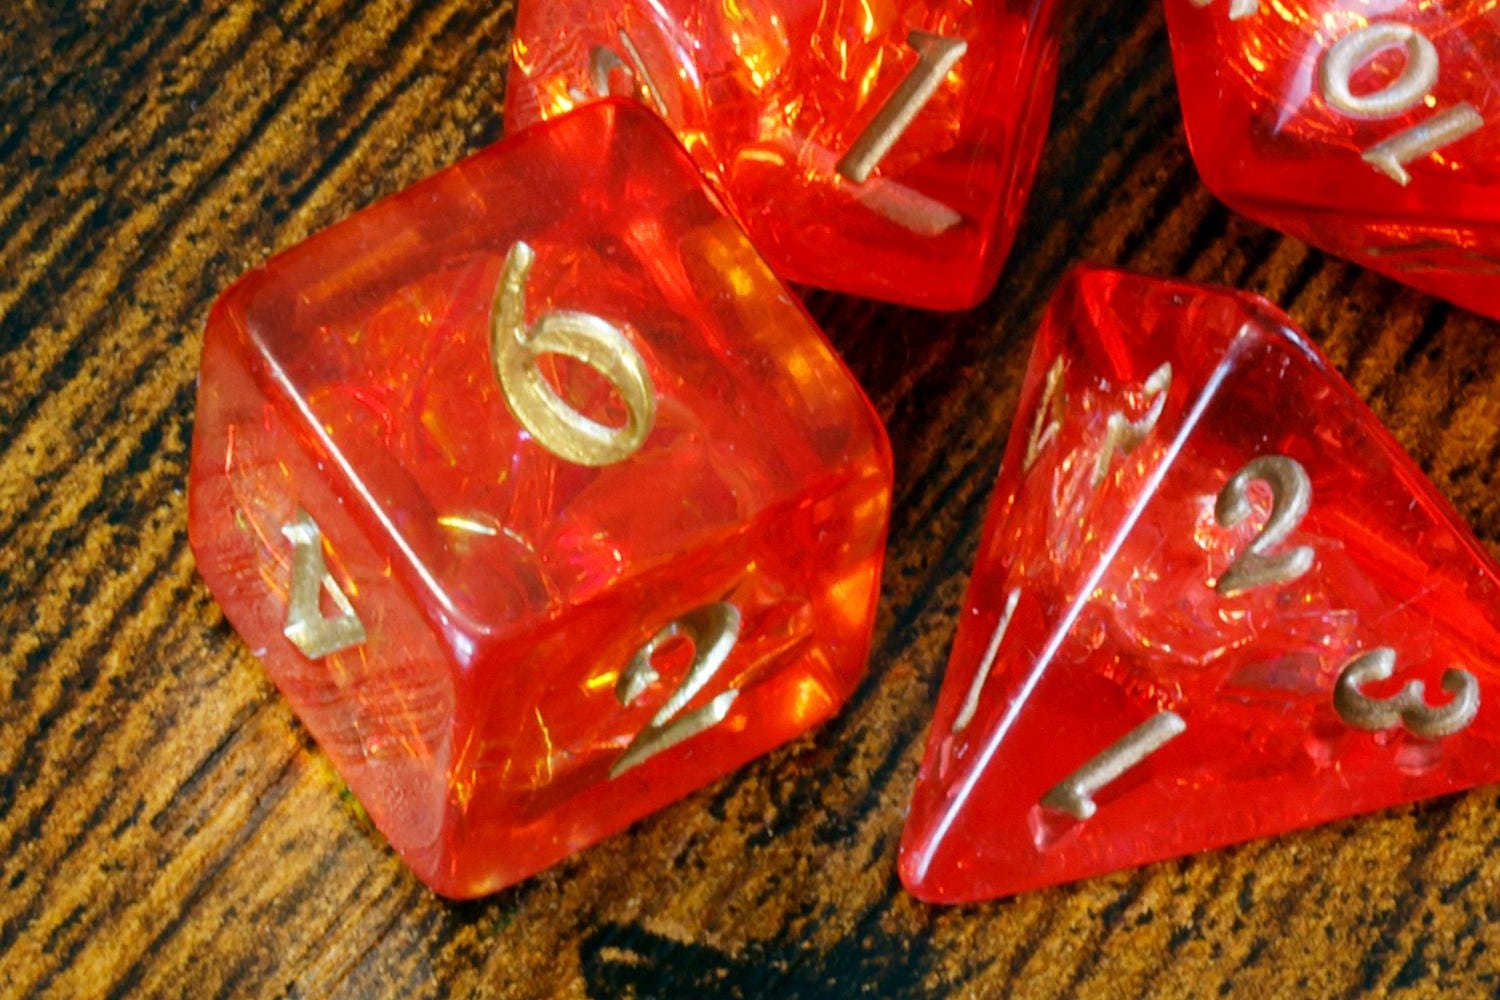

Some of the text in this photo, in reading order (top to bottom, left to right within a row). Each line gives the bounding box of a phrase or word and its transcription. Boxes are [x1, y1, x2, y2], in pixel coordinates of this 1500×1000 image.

[837, 30, 968, 183] 1
[1321, 22, 1483, 185] 10
[490, 241, 656, 467] 6
[1215, 453, 1314, 594] 2
[609, 601, 740, 779] 2
[1039, 711, 1186, 820] 1
[1334, 647, 1480, 739] 3
